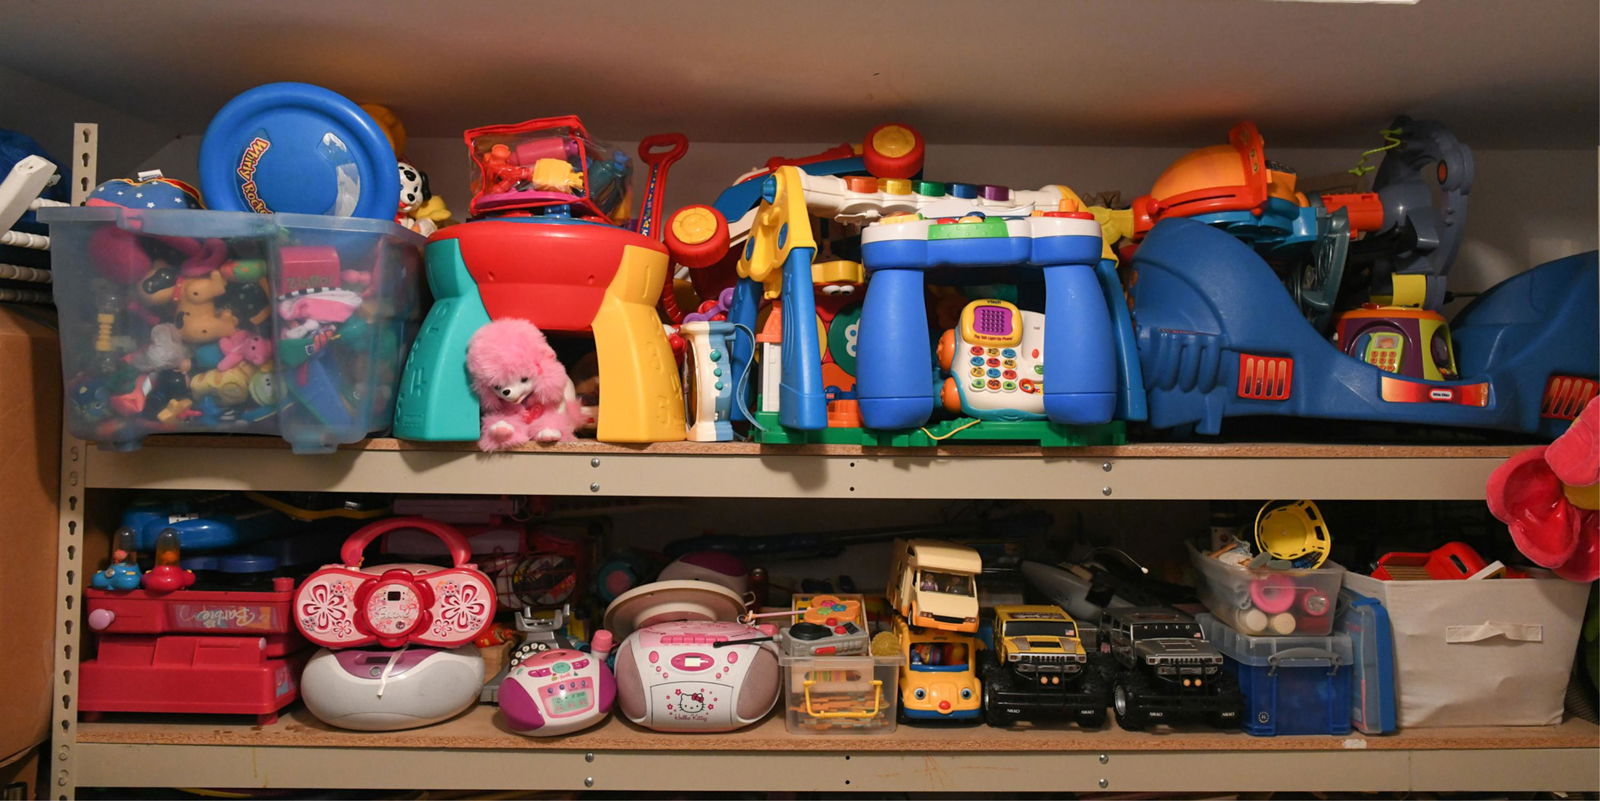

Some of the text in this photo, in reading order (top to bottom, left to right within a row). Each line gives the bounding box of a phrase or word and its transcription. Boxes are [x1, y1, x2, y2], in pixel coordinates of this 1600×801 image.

[237, 137, 272, 214] Whirly Rocke
[197, 606, 256, 627] Barbie
[674, 713, 708, 723] Hello Kitty
